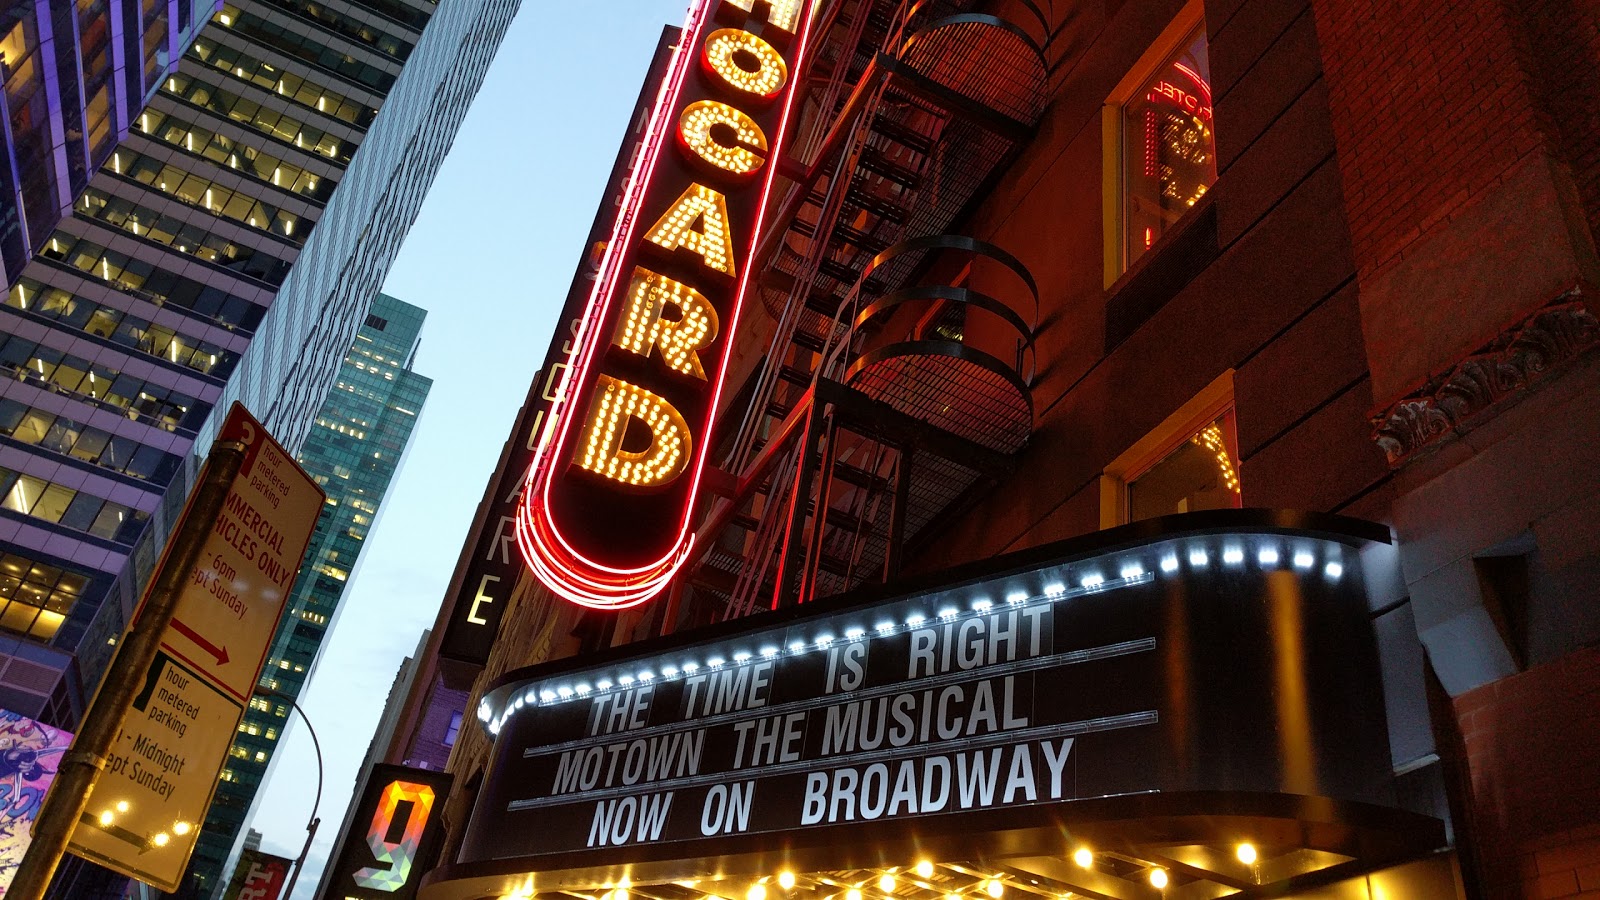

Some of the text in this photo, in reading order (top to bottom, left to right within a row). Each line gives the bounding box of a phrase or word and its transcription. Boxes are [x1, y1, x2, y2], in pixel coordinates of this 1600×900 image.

[263, 445, 283, 468] hour
[250, 475, 280, 509] parking
[257, 461, 290, 496] metered
[212, 554, 236, 582] 6pm
[258, 551, 290, 587] ONLY
[209, 578, 248, 620] Sunday
[165, 666, 190, 691] hour
[590, 605, 1050, 737] THE TIME IS RIGHT
[157, 687, 200, 720] metered
[148, 705, 187, 739] parking
[551, 675, 1029, 795] MOTOWN THE MUSICAL
[132, 733, 186, 776] Midnight
[129, 762, 176, 802] Sunday
[587, 738, 1076, 848] NOW ON BROADWAY
